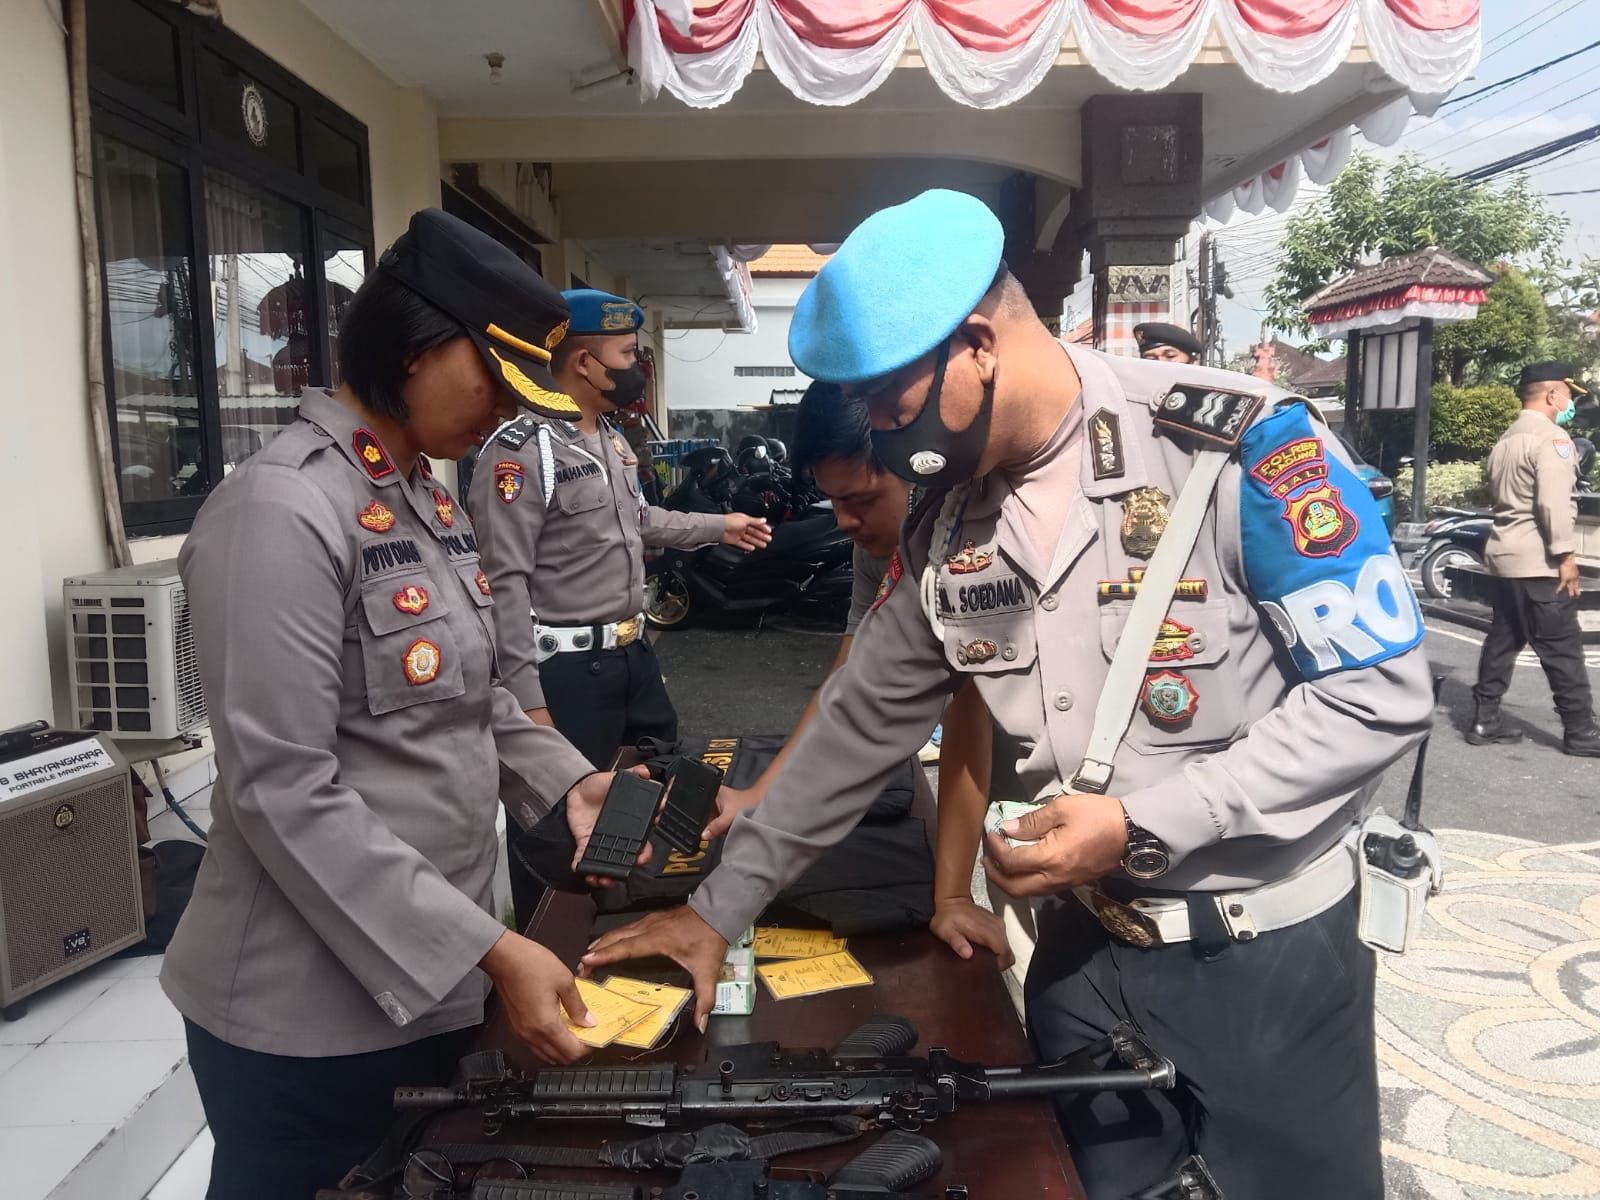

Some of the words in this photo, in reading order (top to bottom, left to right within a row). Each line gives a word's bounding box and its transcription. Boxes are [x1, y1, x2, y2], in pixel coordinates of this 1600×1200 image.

[1260, 441, 1318, 476] POLRES
[1269, 449, 1317, 477] BADUNG
[1278, 467, 1323, 493] BALI
[959, 577, 1026, 613] SOEDANA
[9, 774, 57, 793] PORTABLE
[57, 760, 100, 778] MANPACK
[13, 748, 104, 781] BHAYANGKARA
